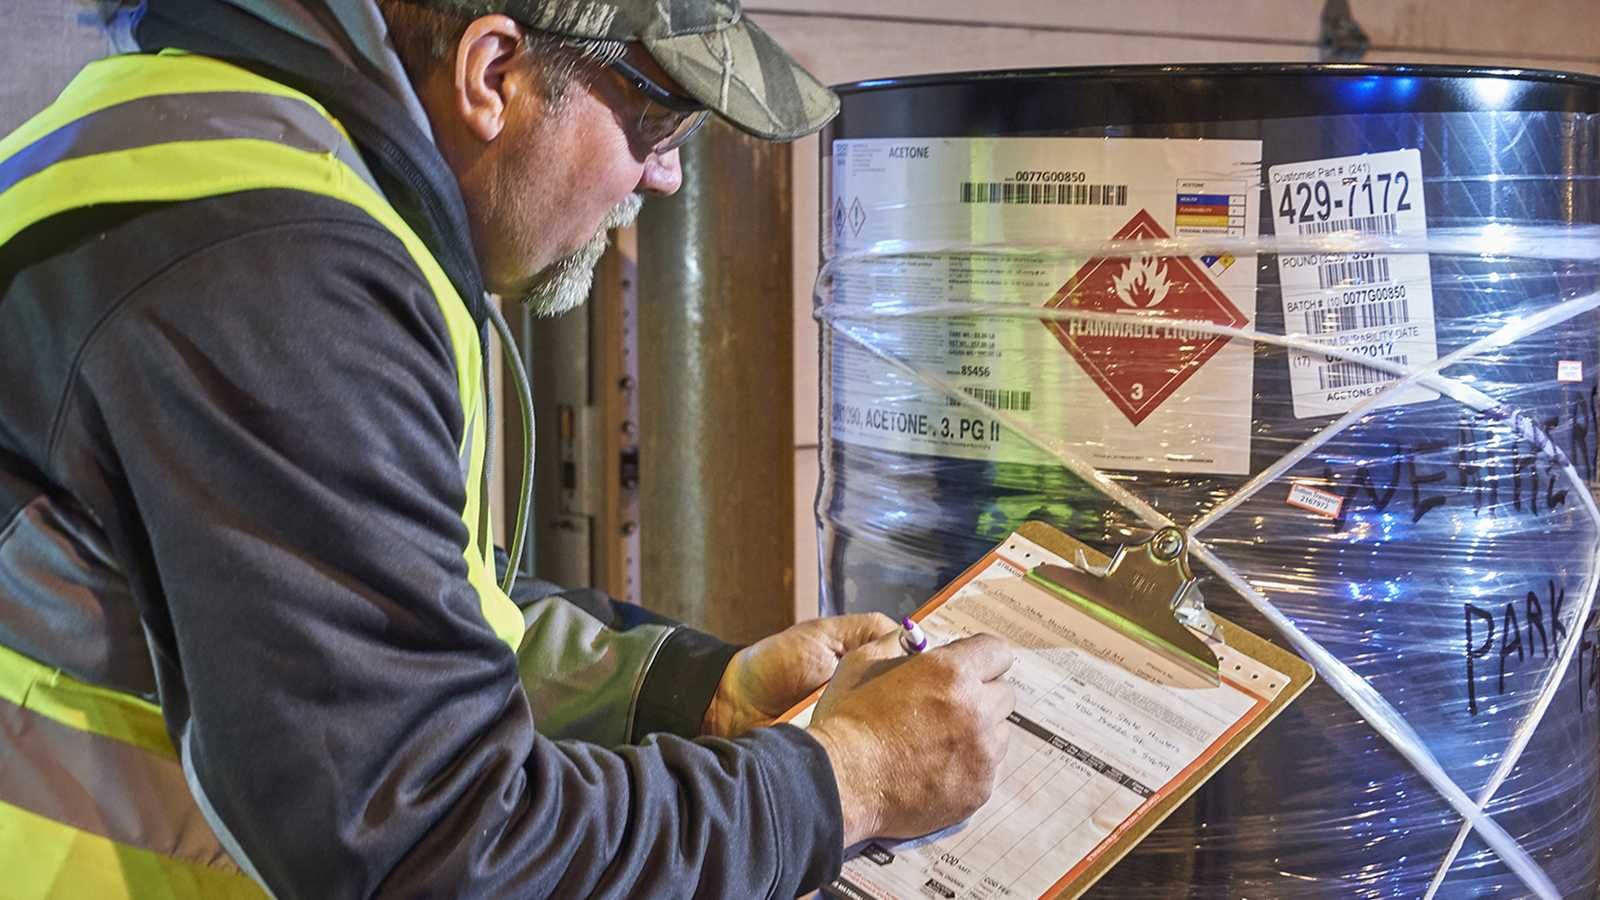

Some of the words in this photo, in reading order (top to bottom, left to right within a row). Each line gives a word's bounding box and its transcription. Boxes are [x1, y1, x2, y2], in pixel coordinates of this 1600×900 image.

[889, 146, 929, 159] ACETONE
[1015, 171, 1086, 182] 0077G00850
[1273, 169, 1316, 183] Customer
[1318, 167, 1336, 177] Part
[1279, 171, 1412, 225] 429-7172
[1282, 254, 1318, 267] POUND
[1287, 300, 1317, 313] BATCH
[1343, 285, 1406, 305] 0077G00850
[1069, 316, 1161, 339] FLAMMABLE
[960, 365, 991, 377] 85456
[1131, 383, 1144, 400] 3
[1327, 387, 1373, 402] ACETONE
[960, 418, 985, 441] PG
[1464, 578, 1567, 717] PARK
